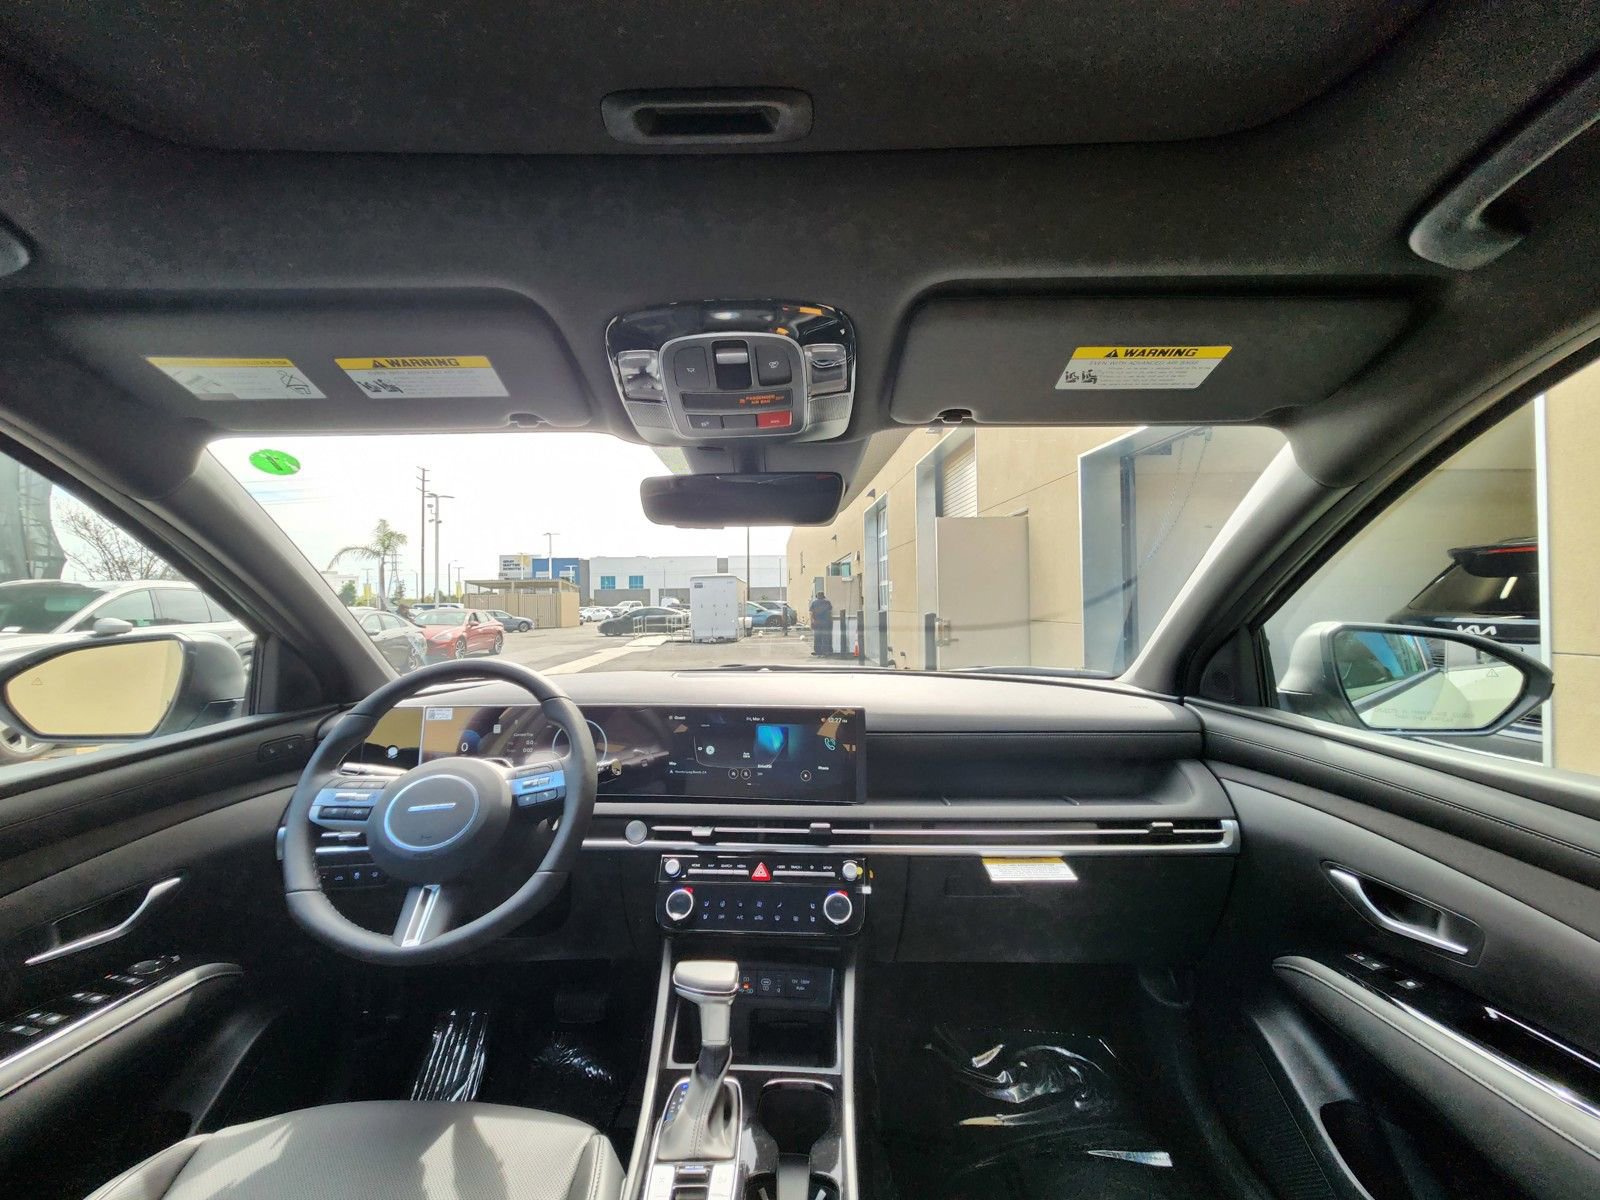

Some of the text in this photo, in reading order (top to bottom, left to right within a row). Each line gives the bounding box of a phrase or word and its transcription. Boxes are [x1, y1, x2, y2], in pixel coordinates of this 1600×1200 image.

[1123, 348, 1199, 358] WARNING
[384, 358, 460, 368] WARNING
[461, 742, 469, 752] 0
